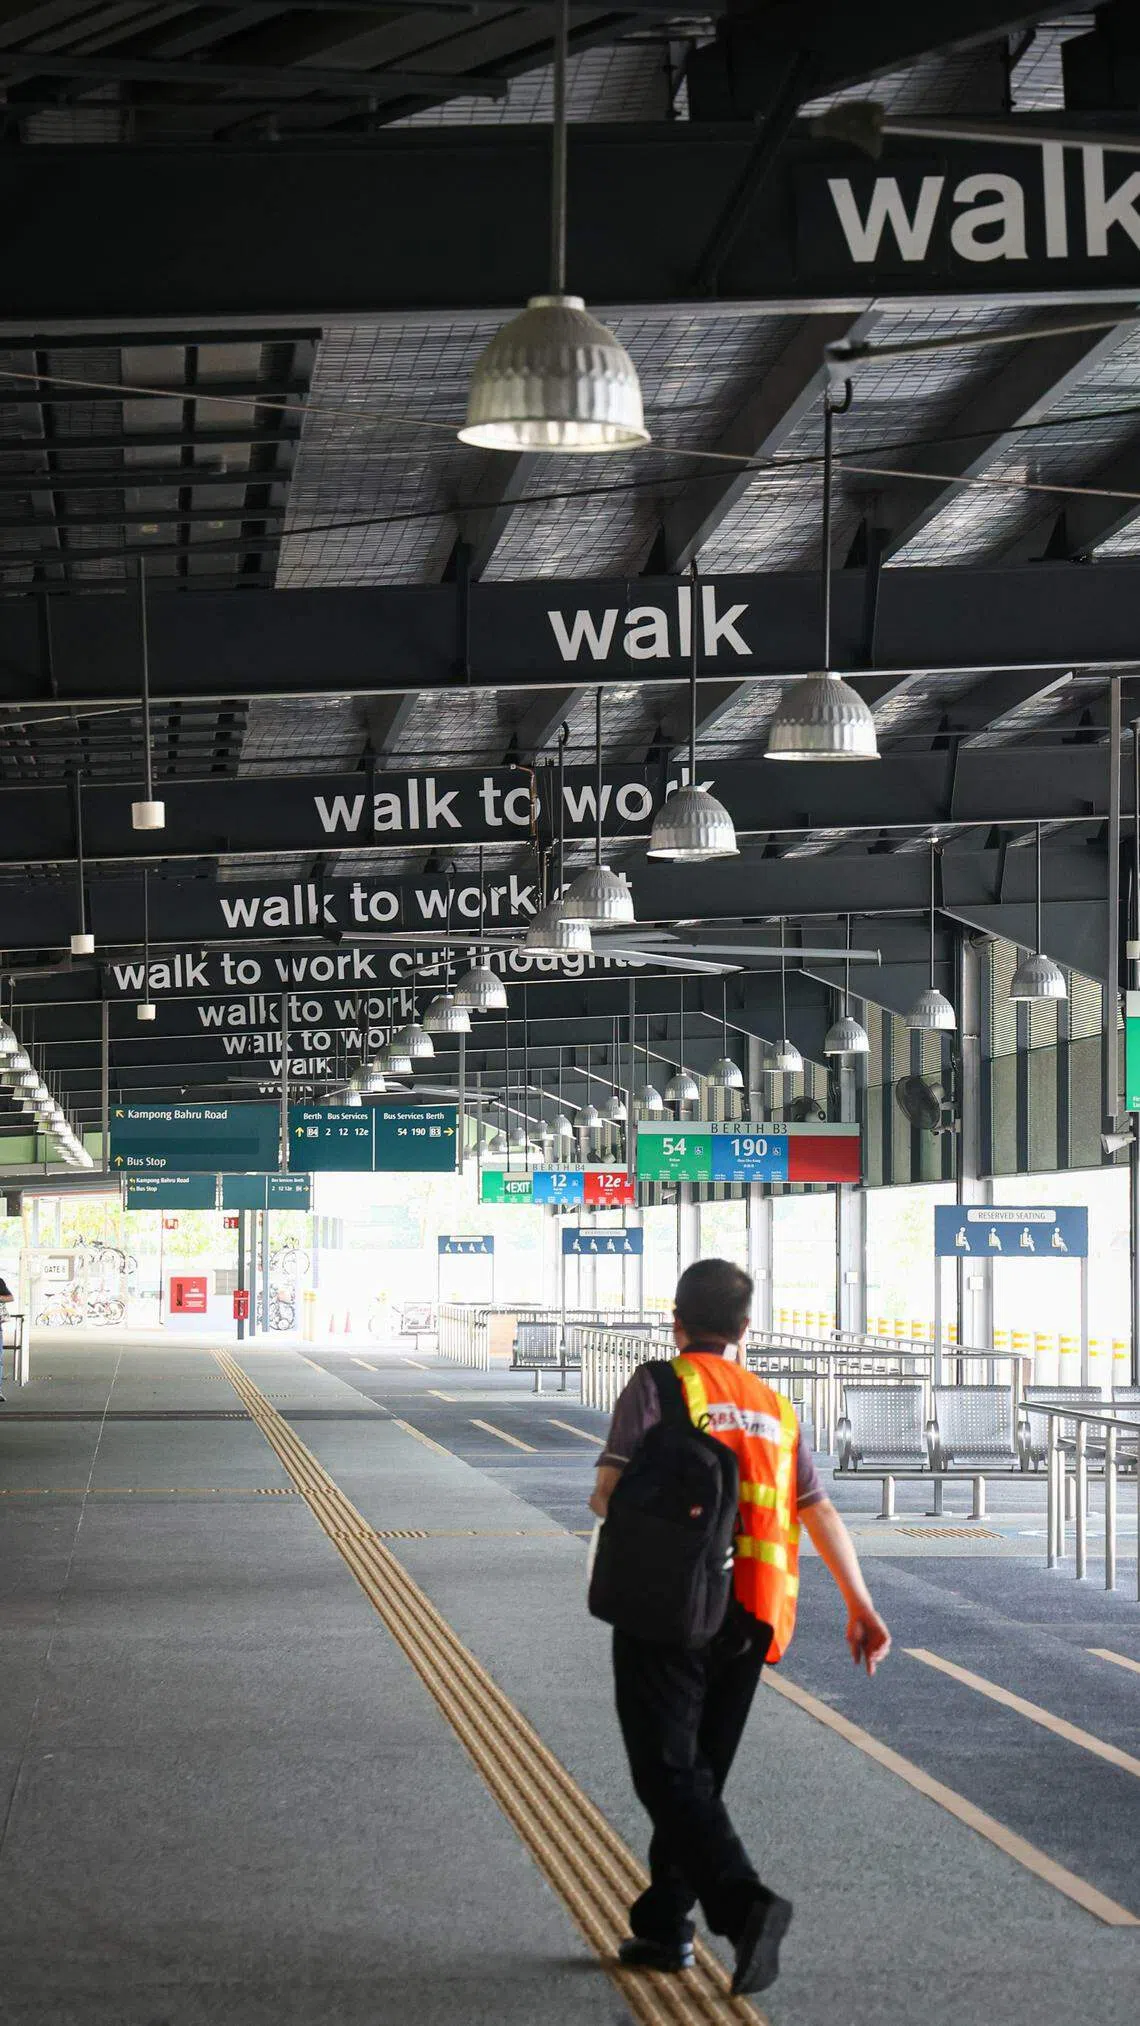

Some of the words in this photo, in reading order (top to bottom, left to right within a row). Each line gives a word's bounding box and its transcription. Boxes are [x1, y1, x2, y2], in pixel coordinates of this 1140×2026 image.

[827, 142, 1140, 263] walk
[547, 585, 754, 662] walk
[314, 777, 462, 833] walk
[479, 777, 542, 827] to
[220, 882, 339, 928] walk
[350, 882, 401, 923] to
[415, 874, 538, 919] work
[113, 952, 211, 990] walk
[220, 952, 263, 985] to
[275, 948, 378, 982] work
[389, 946, 456, 977] out
[197, 995, 280, 1027] walk
[288, 995, 324, 1023] to
[334, 988, 420, 1020] work
[222, 1031, 294, 1055] walk
[302, 1029, 331, 1051] to
[340, 1026, 403, 1048] wor
[269, 1056, 333, 1076] walk
[127, 1110, 172, 1121] Kampong
[174, 1110, 202, 1119] Bahru
[205, 1110, 228, 1119] Road
[303, 1112, 322, 1120] Berth
[327, 1112, 340, 1120] Bus
[341, 1112, 368, 1120] Services
[383, 1112, 396, 1120] Bus
[397, 1112, 424, 1120] Services
[426, 1112, 444, 1120] Berth
[325, 1128, 331, 1136] 2
[339, 1128, 348, 1136] 12
[355, 1128, 369, 1136] 12e
[397, 1128, 408, 1136] 54
[412, 1128, 425, 1136] 190
[711, 1123, 764, 1134] BERTH
[773, 1124, 788, 1134] B3
[662, 1138, 687, 1155] 54
[731, 1139, 768, 1156] 190
[127, 1157, 144, 1166] Bus
[146, 1157, 167, 1168] Stop
[511, 1182, 530, 1193] EXIT
[550, 1175, 567, 1187] 12
[597, 1175, 621, 1187] 12e
